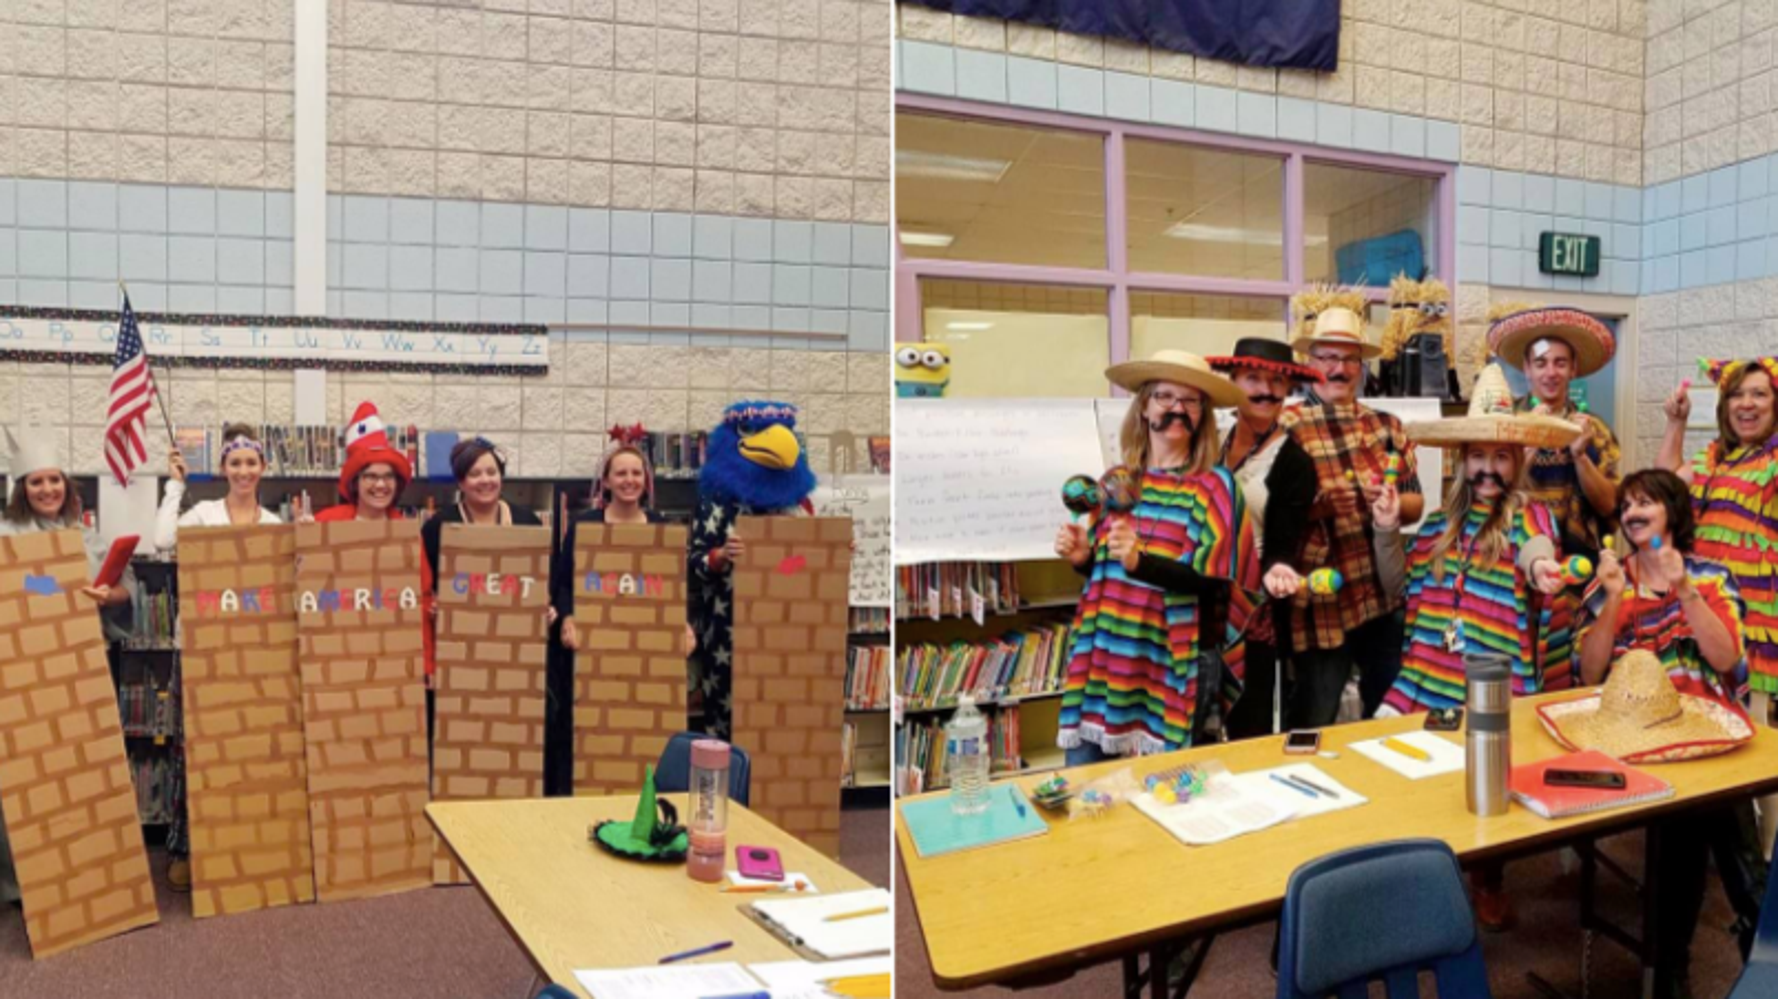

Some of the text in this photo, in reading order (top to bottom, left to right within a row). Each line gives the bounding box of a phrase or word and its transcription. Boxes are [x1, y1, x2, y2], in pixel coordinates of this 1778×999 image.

[1552, 235, 1588, 273] EXIT
[49, 322, 74, 344] Pp
[149, 325, 172, 345] Rr
[200, 327, 221, 346] Ss
[250, 328, 268, 347] Tt
[293, 331, 318, 348] Uu
[341, 332, 362, 350] Vv
[382, 333, 415, 351] Ww
[433, 335, 454, 352] Xx
[477, 336, 497, 361] Yy
[521, 336, 542, 355] Zz
[196, 572, 663, 614] MAKE AMERICA GREAT AGAIN
